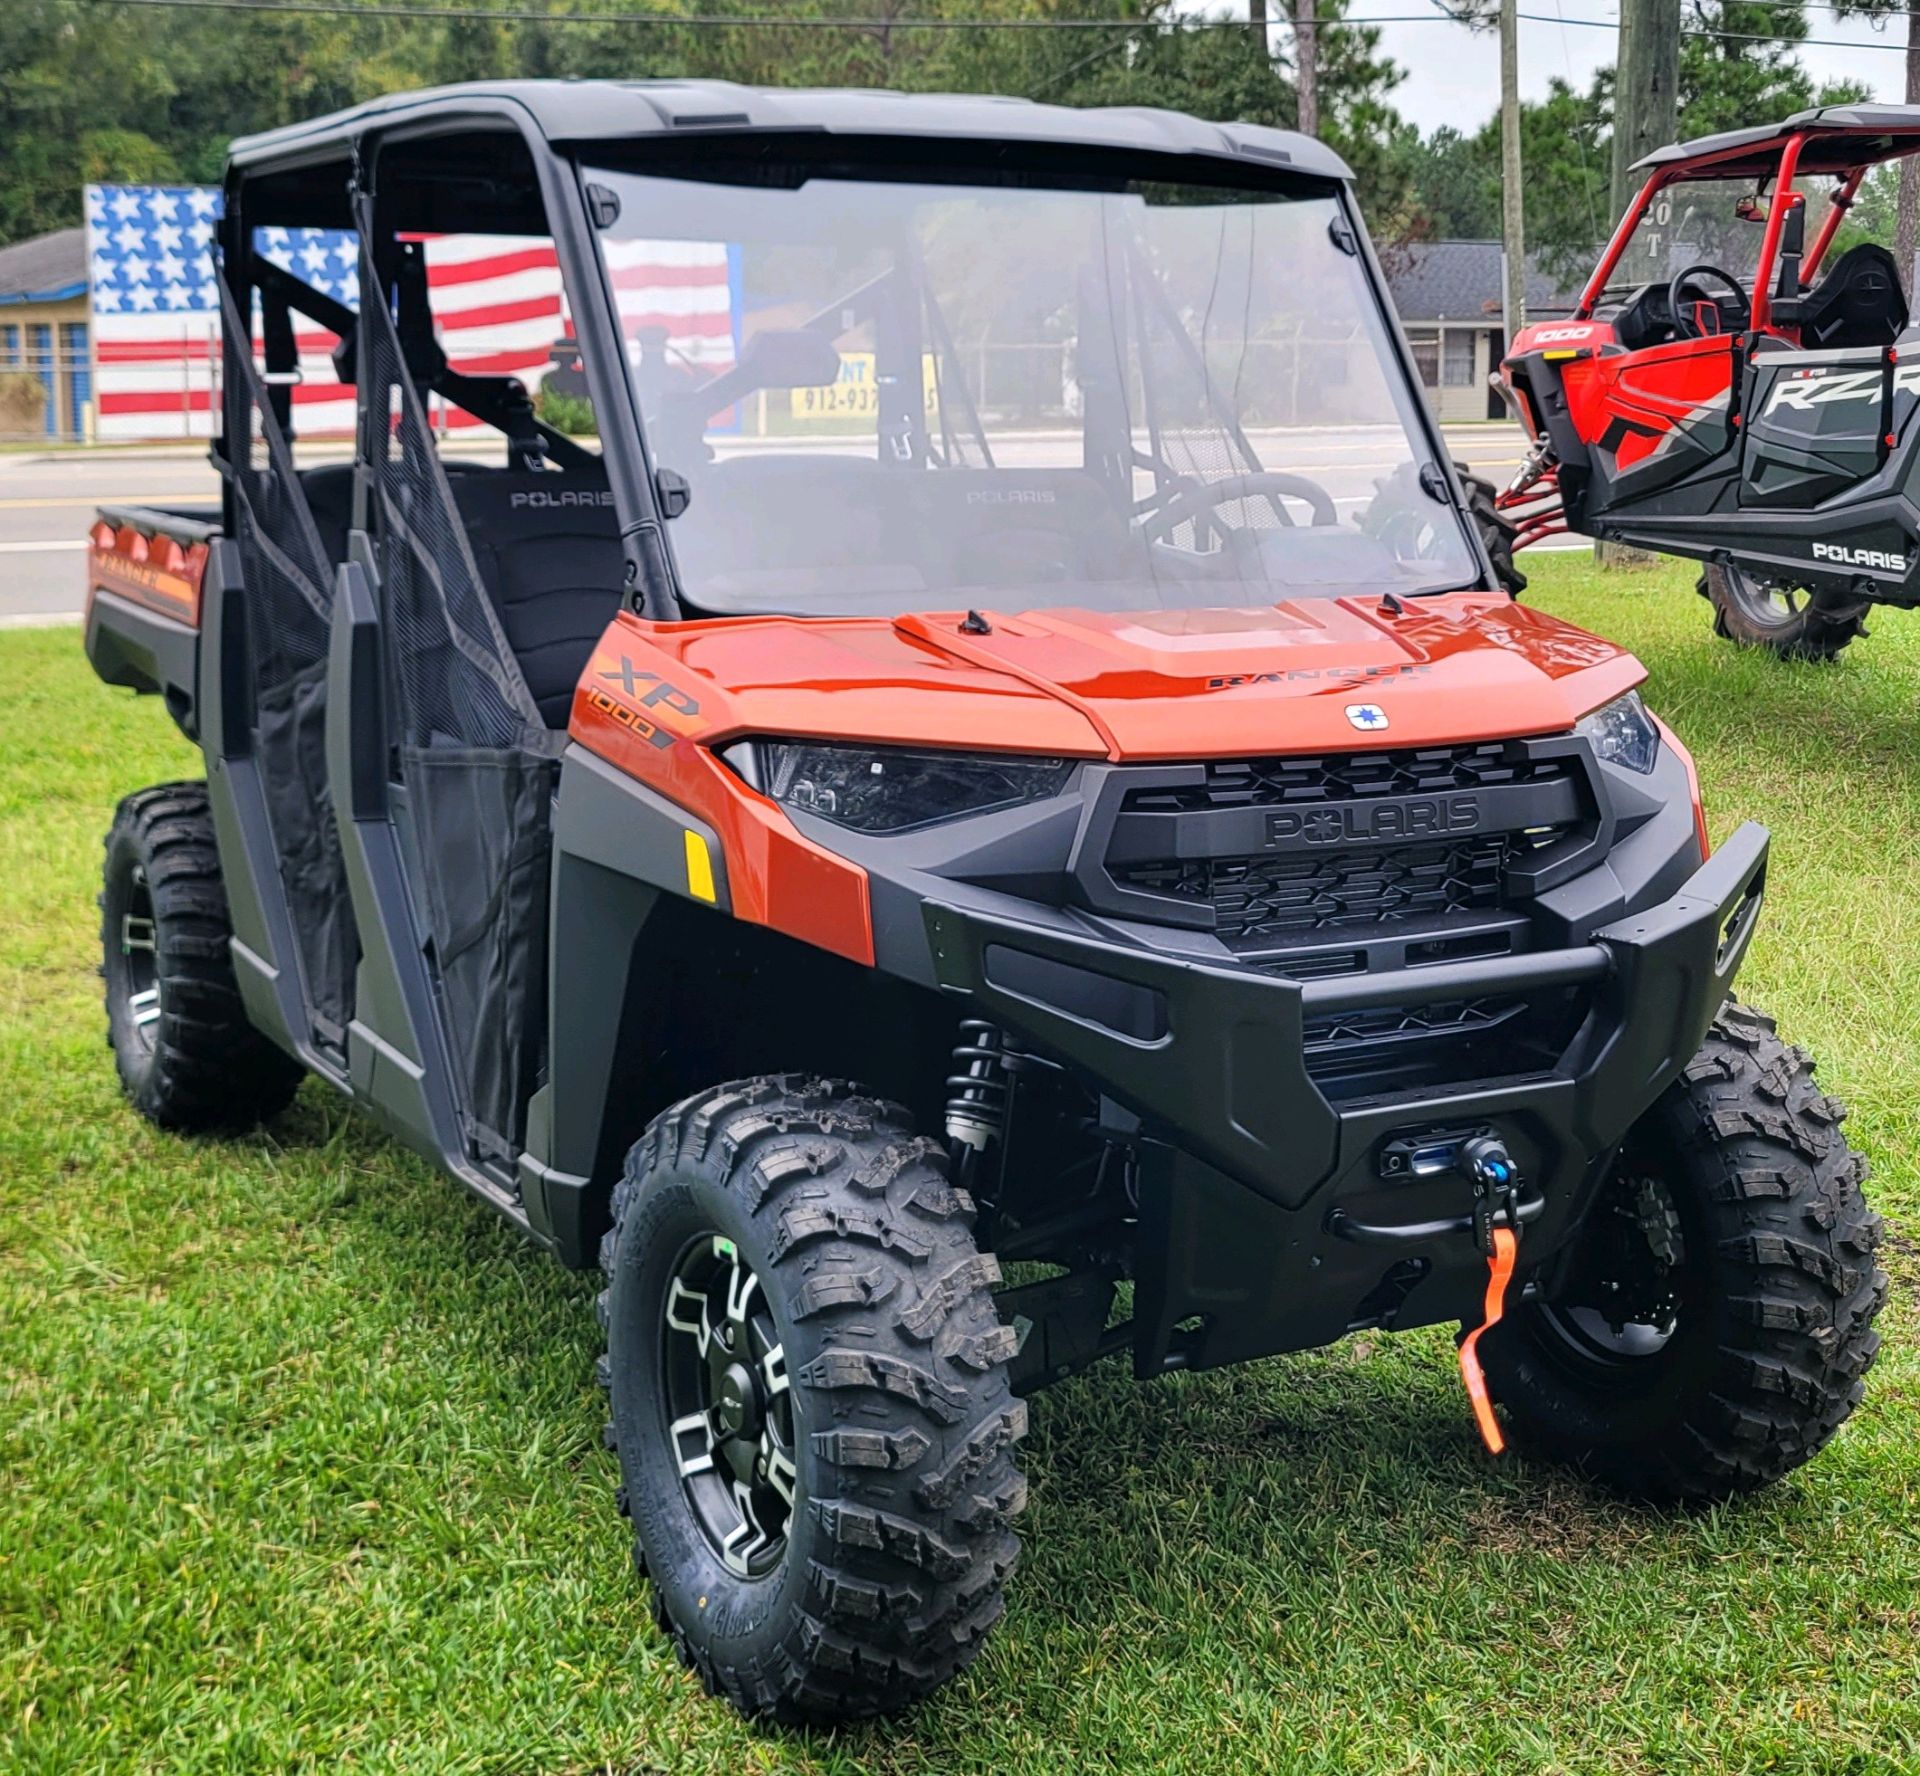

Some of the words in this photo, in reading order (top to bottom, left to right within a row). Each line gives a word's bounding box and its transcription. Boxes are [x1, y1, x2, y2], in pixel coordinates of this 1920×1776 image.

[1533, 326, 1594, 343] 1000
[840, 360, 867, 384] NT
[510, 490, 615, 508] POLARIS
[967, 489, 1056, 505] POLARIS
[1812, 542, 1906, 571] POLARIS
[598, 655, 700, 716] XP
[1208, 665, 1432, 688] RANGER
[586, 685, 657, 740] 1000
[1265, 796, 1481, 848] POLARIS
